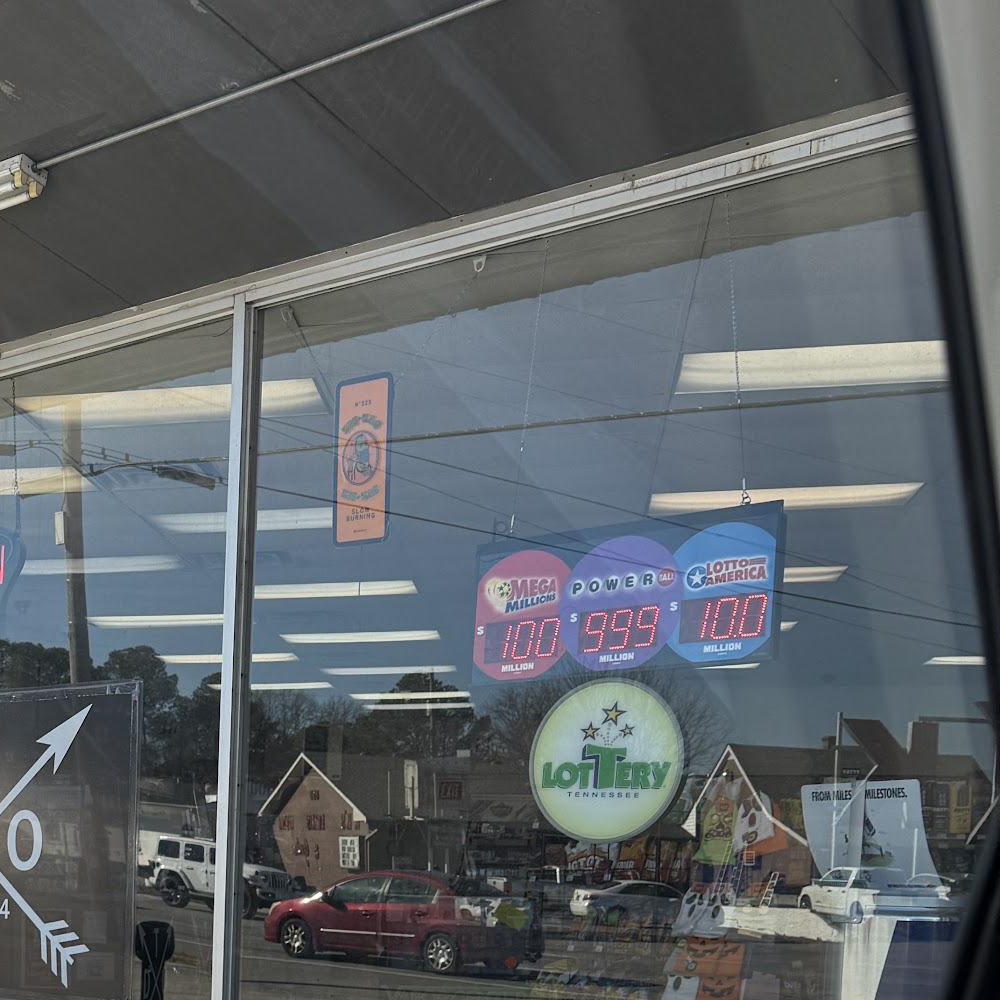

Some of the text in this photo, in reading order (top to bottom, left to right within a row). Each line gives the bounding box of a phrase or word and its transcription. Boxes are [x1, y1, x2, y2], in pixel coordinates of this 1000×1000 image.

[346, 512, 375, 522] BURNING
[705, 566, 767, 586] AMERICA
[706, 559, 749, 576] LOTTO
[510, 578, 556, 600] MEGA
[572, 573, 654, 594] POWER
[504, 593, 556, 614] MILLIONS
[502, 618, 560, 660] 100
[583, 606, 660, 653] 999
[599, 652, 634, 663] MILLION
[703, 642, 742, 653] MILLION
[501, 662, 534, 672] MILLION
[542, 744, 672, 789] LOTTERY
[812, 788, 908, 801] FROM MILES MILESTONES.
[7, 810, 42, 872] O
